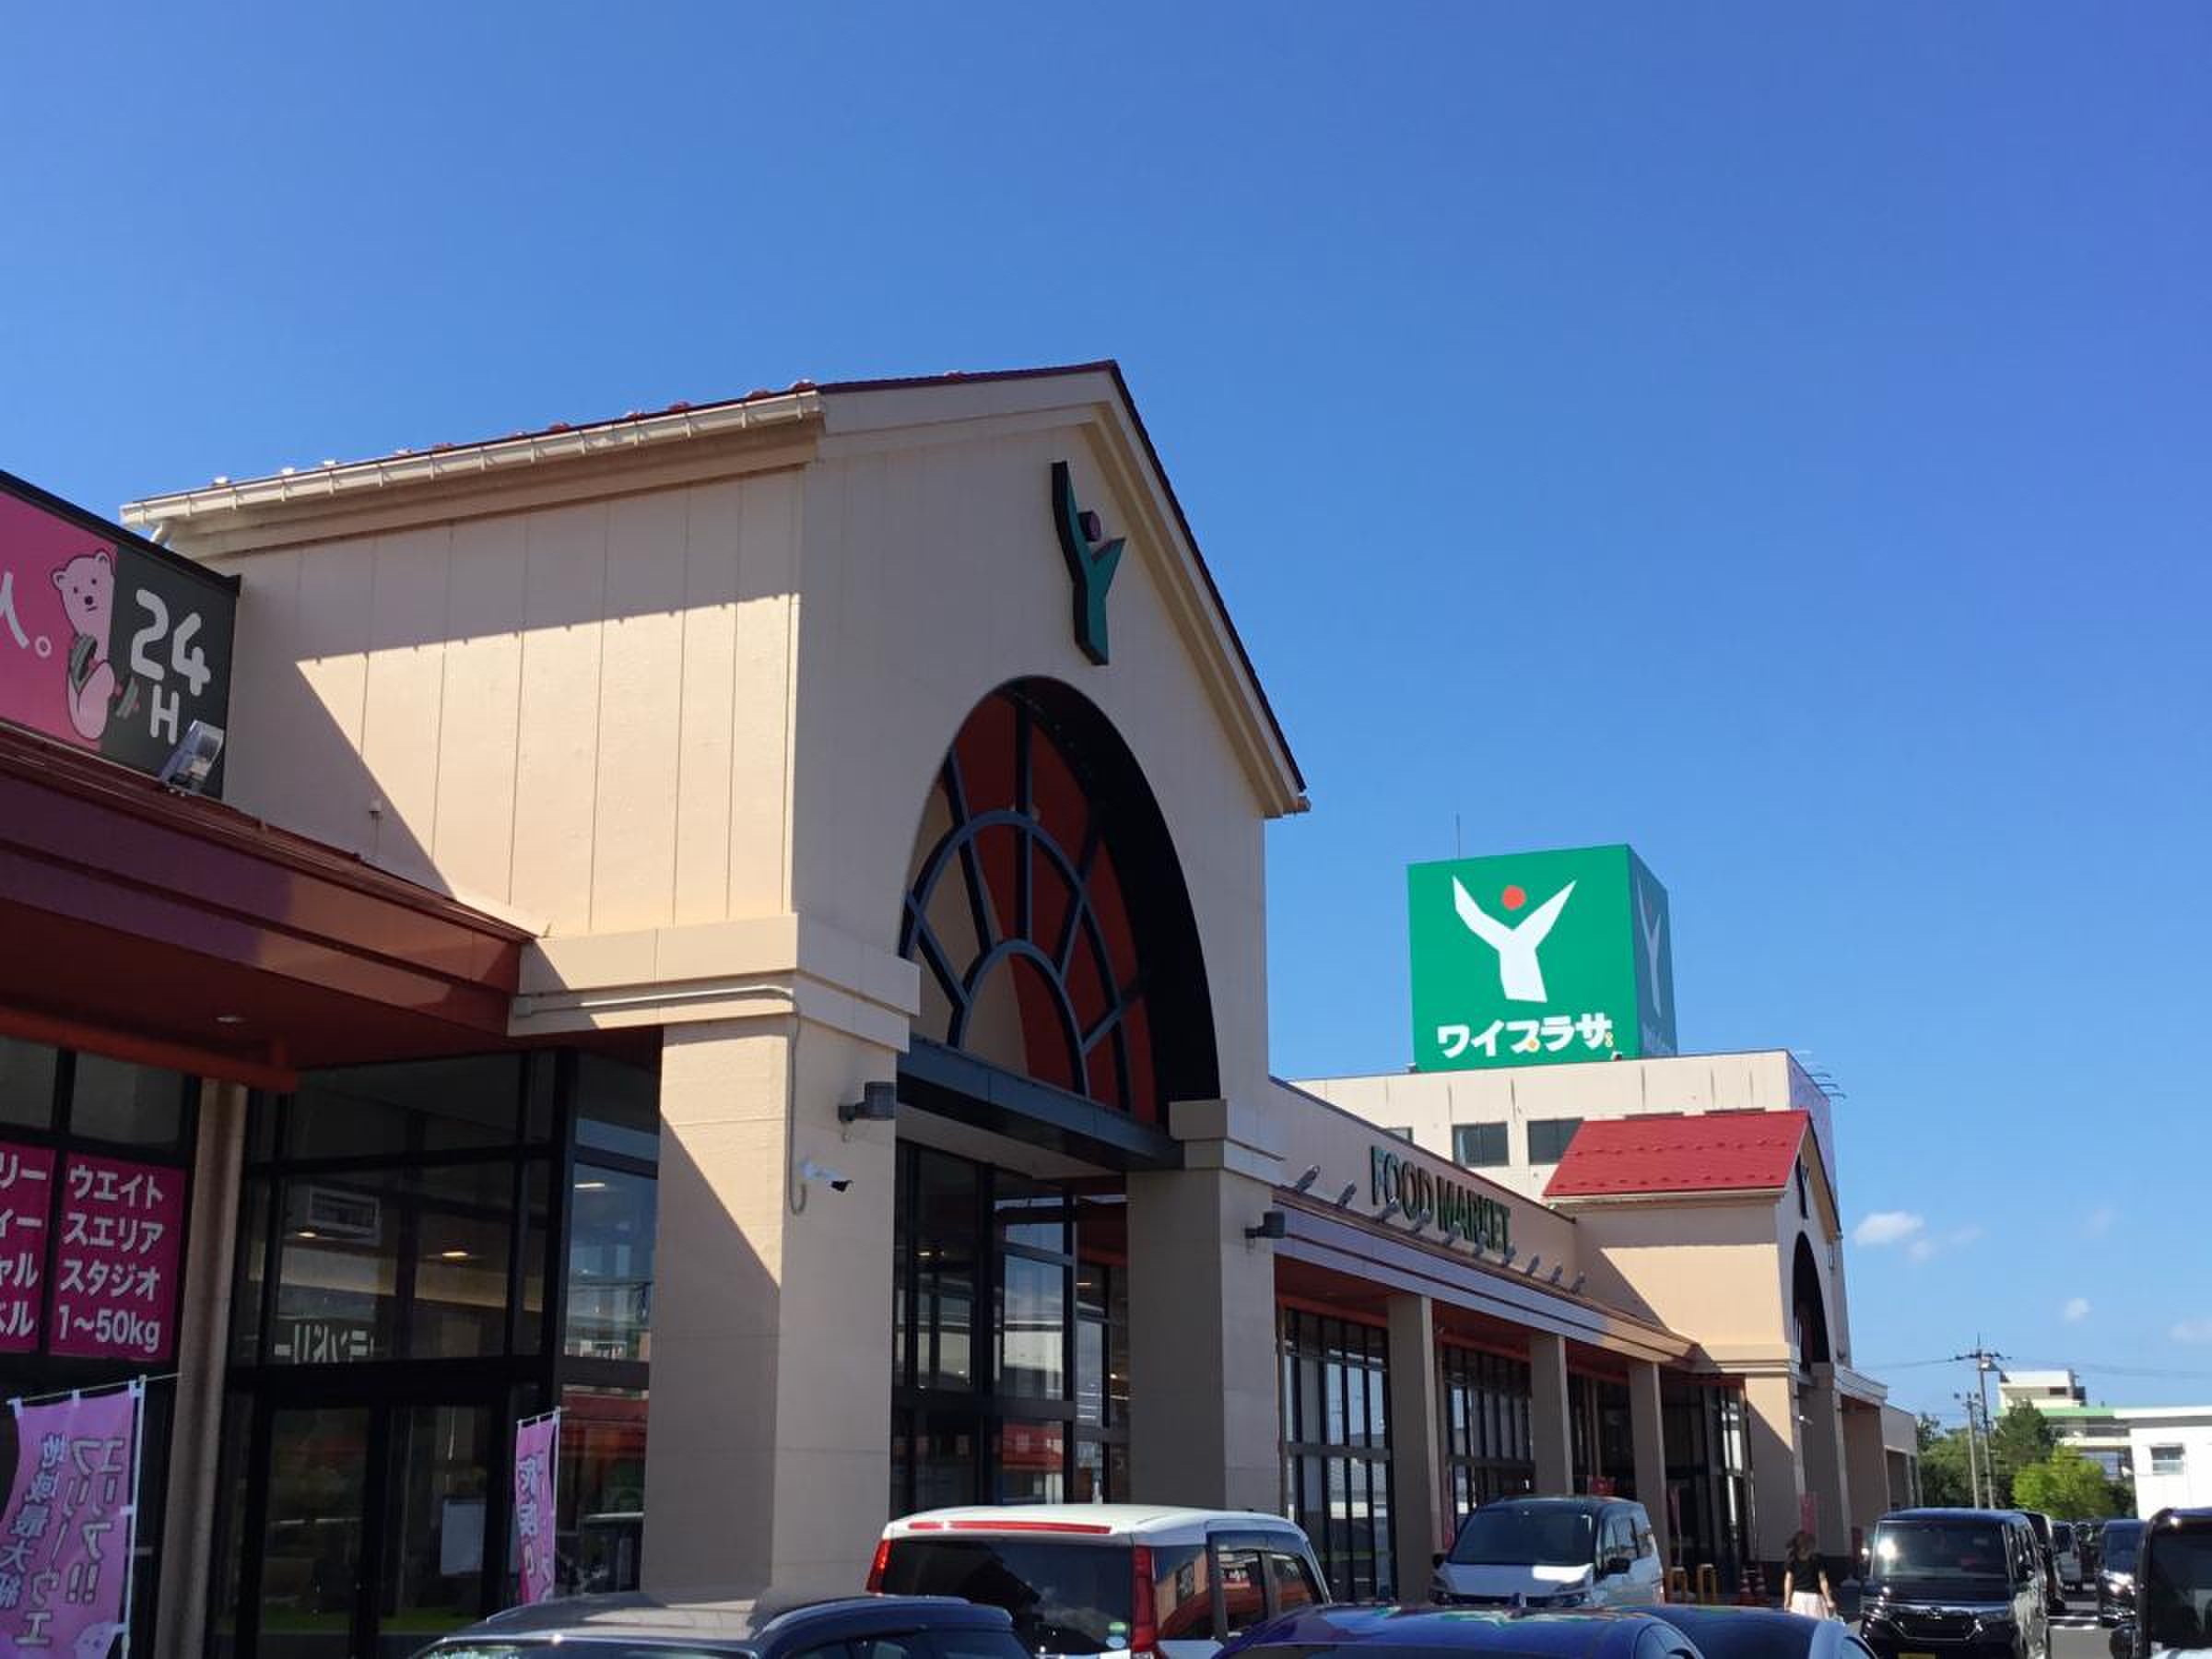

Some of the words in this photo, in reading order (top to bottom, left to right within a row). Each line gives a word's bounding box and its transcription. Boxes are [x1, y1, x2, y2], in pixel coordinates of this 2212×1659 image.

[131, 588, 212, 697] 24
[69, 1164, 164, 1209] ウエイト
[1371, 1146, 1434, 1224] FOOD
[1436, 1175, 1511, 1253] MARKET
[63, 1212, 165, 1254] スエリア
[59, 1259, 161, 1301] スタジオ
